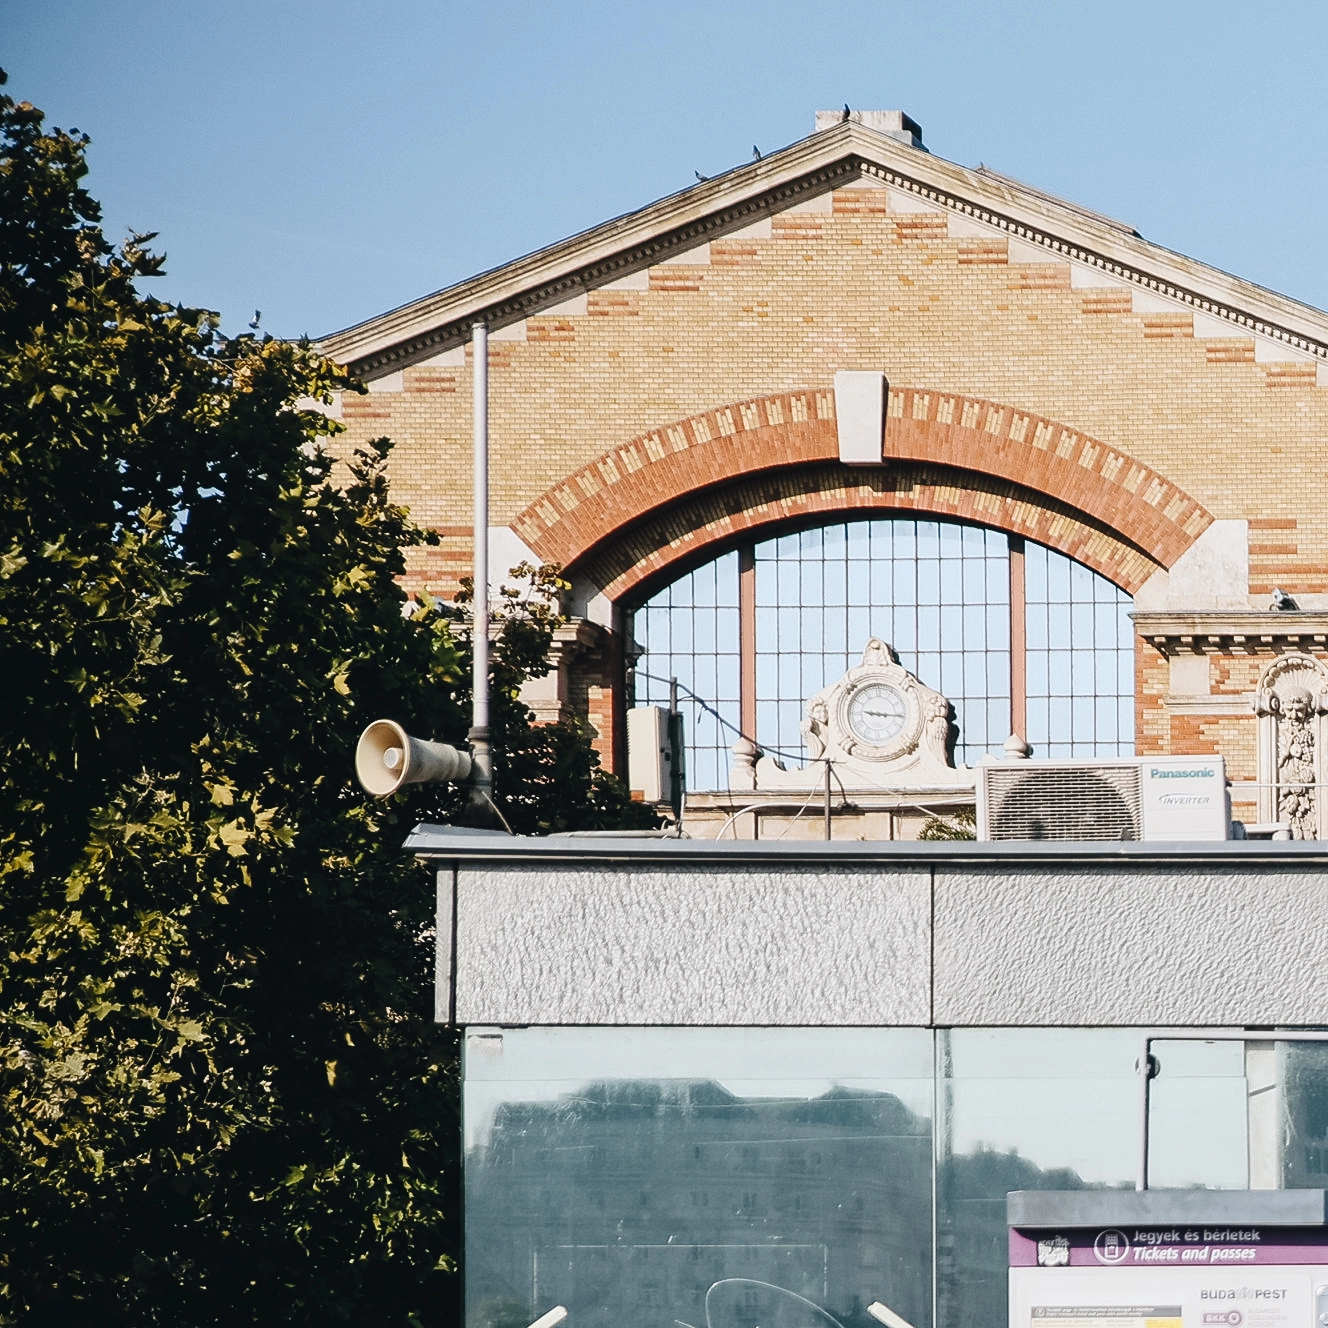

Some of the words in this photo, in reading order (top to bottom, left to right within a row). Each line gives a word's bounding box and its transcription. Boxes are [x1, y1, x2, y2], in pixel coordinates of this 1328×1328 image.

[1150, 767, 1215, 779] Panasonic
[1163, 796, 1210, 805] INVERTER
[1133, 1229, 1180, 1245] Jegyek
[1184, 1229, 1200, 1242] és
[1203, 1229, 1261, 1242] bérletek
[1133, 1246, 1179, 1261] Tickets
[1181, 1246, 1208, 1260] and
[1210, 1248, 1257, 1263] passes
